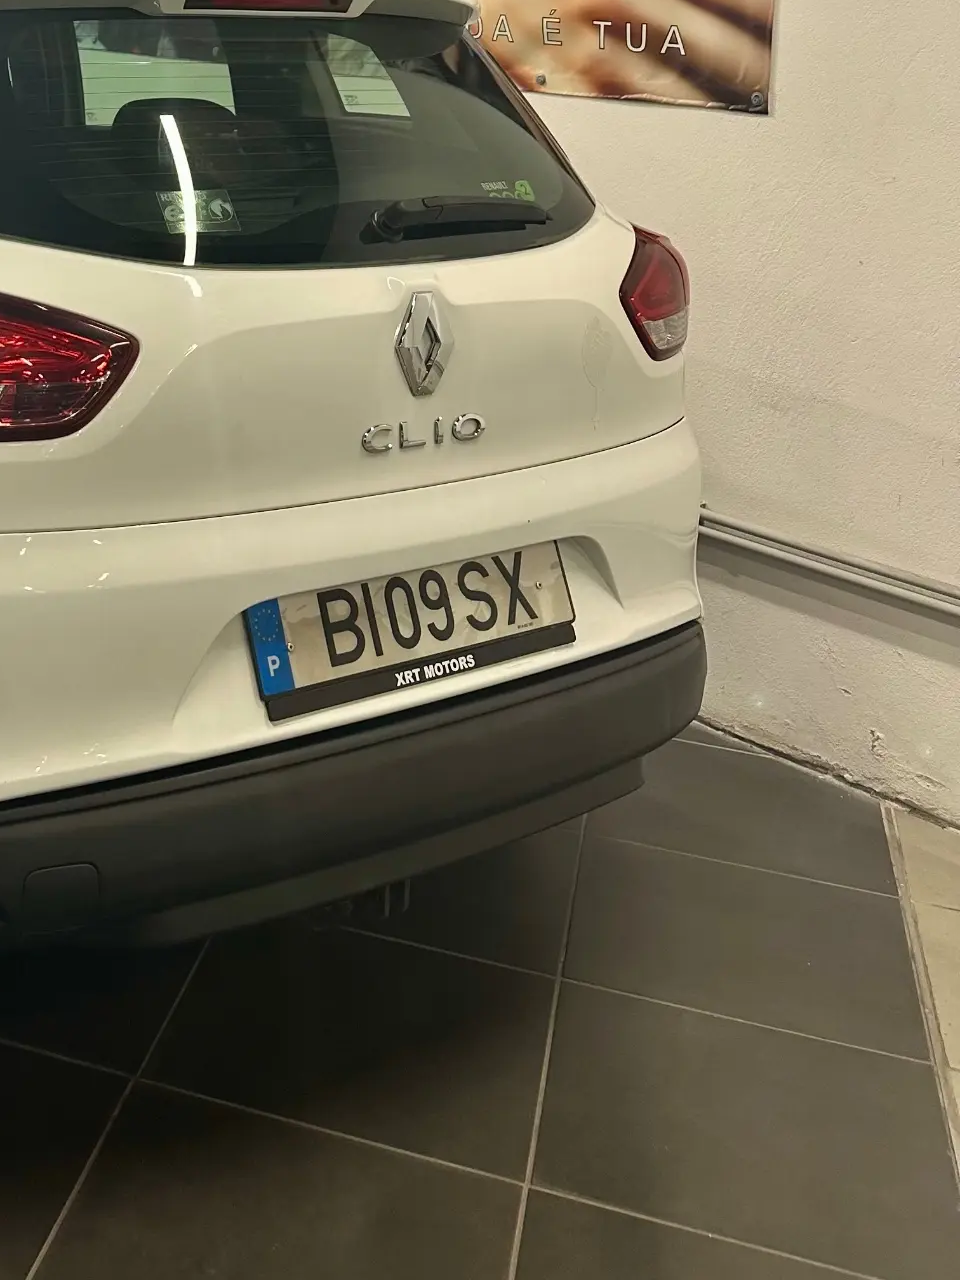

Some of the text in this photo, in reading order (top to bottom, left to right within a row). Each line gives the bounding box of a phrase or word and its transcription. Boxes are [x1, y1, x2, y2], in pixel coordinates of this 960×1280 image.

[542, 9, 563, 46] É
[592, 19, 687, 56] TUA
[362, 413, 486, 454] CLIO
[267, 655, 280, 677] P
[394, 654, 476, 687] XRT MOTORS
